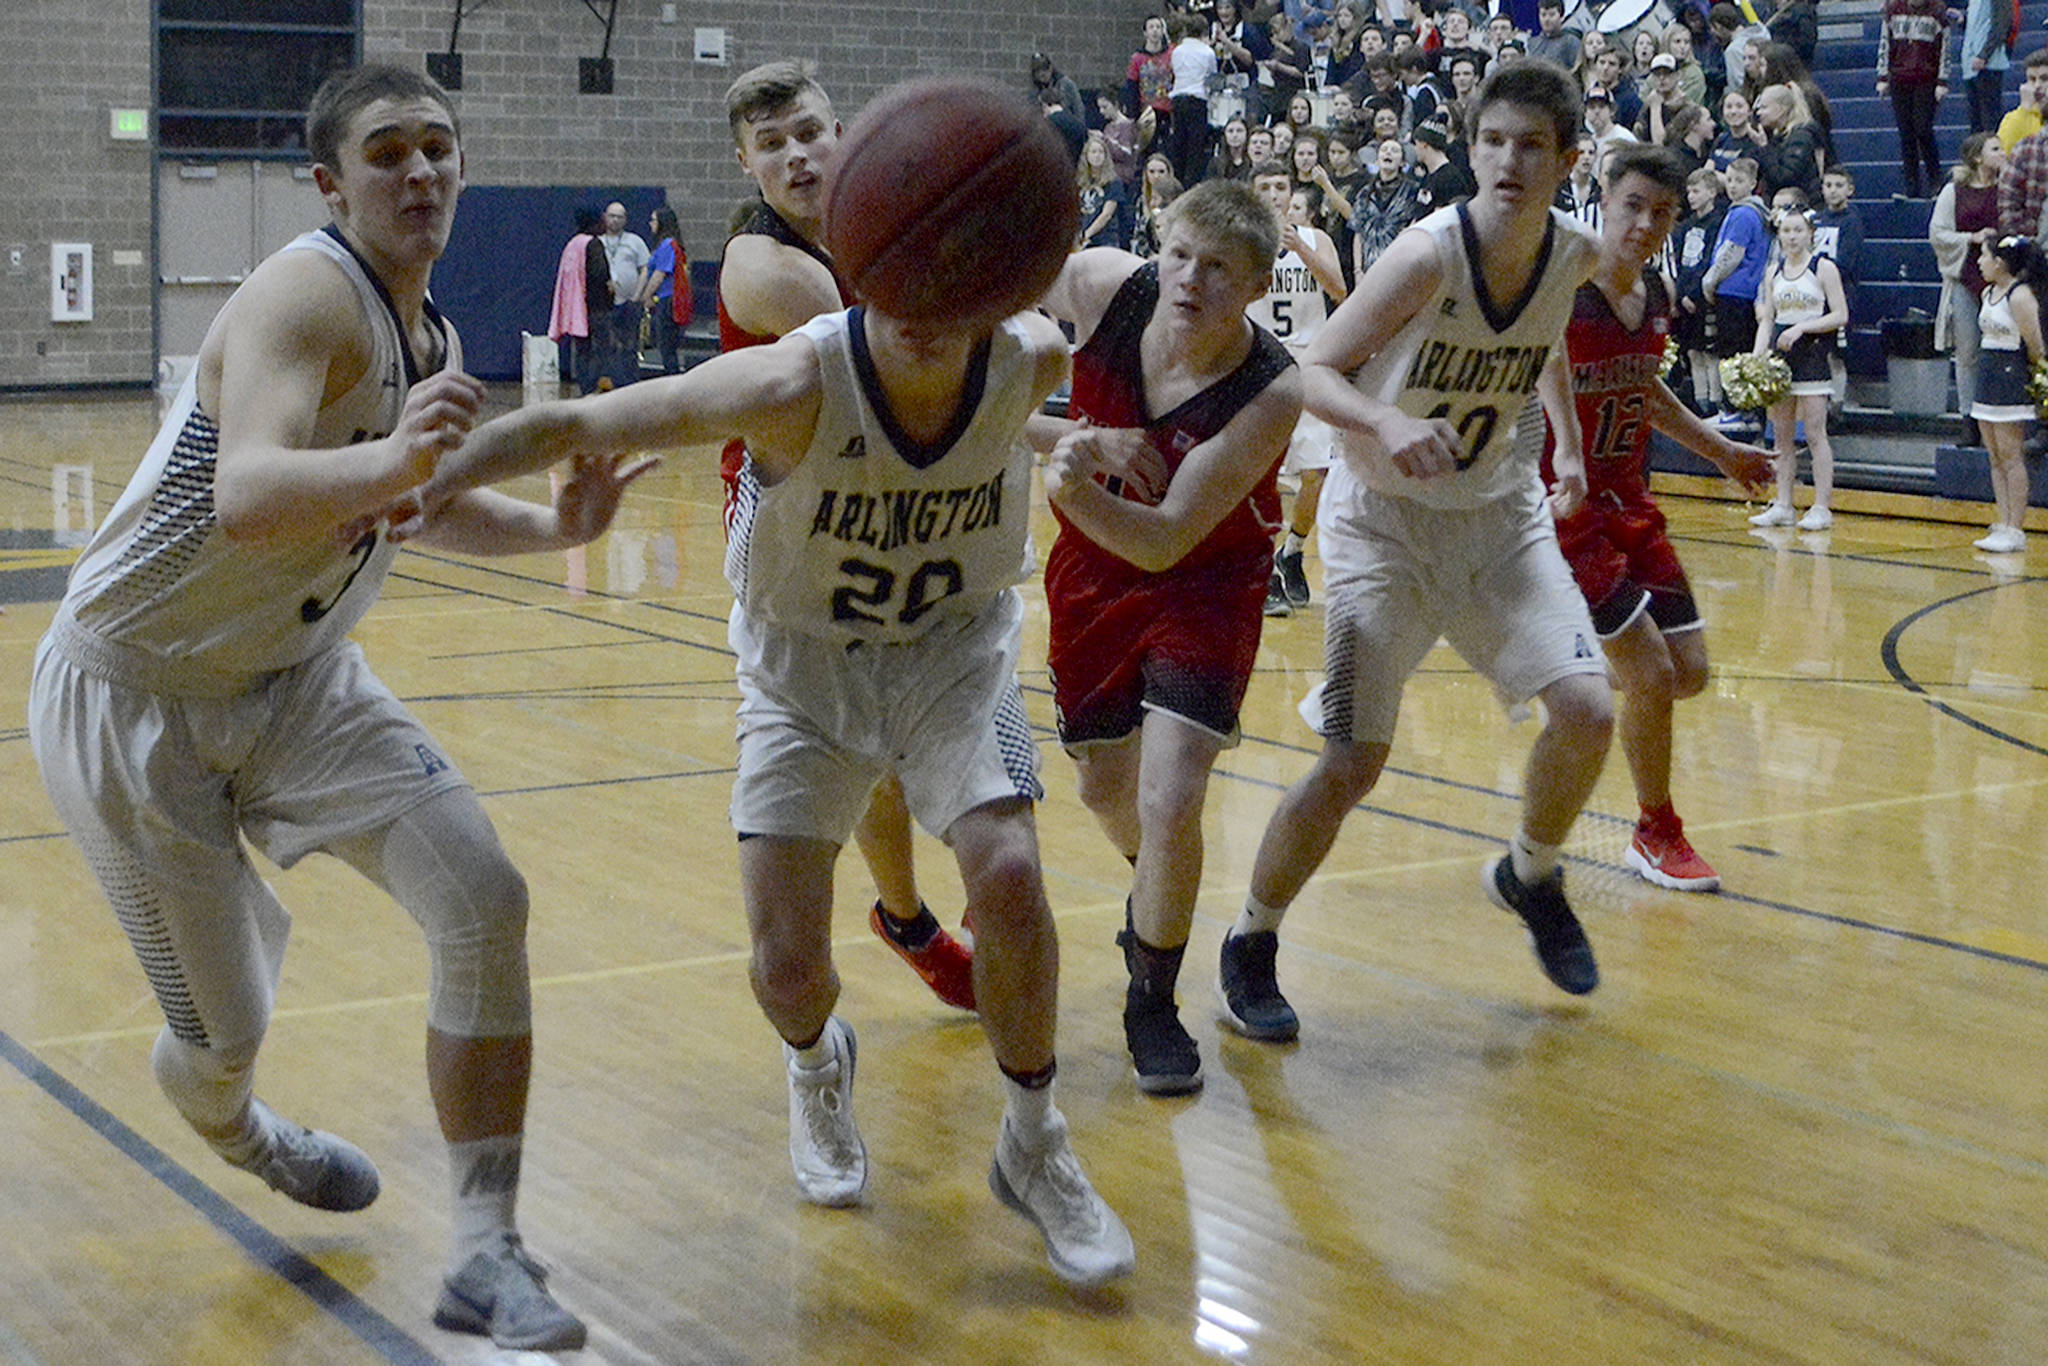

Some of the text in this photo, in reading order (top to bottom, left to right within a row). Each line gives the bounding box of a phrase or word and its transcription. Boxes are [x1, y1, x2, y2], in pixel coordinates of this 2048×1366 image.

[1272, 300, 1293, 338] 5
[1591, 393, 1645, 459] 12
[807, 467, 1007, 552] ARLINGTON
[830, 557, 964, 627] 20
